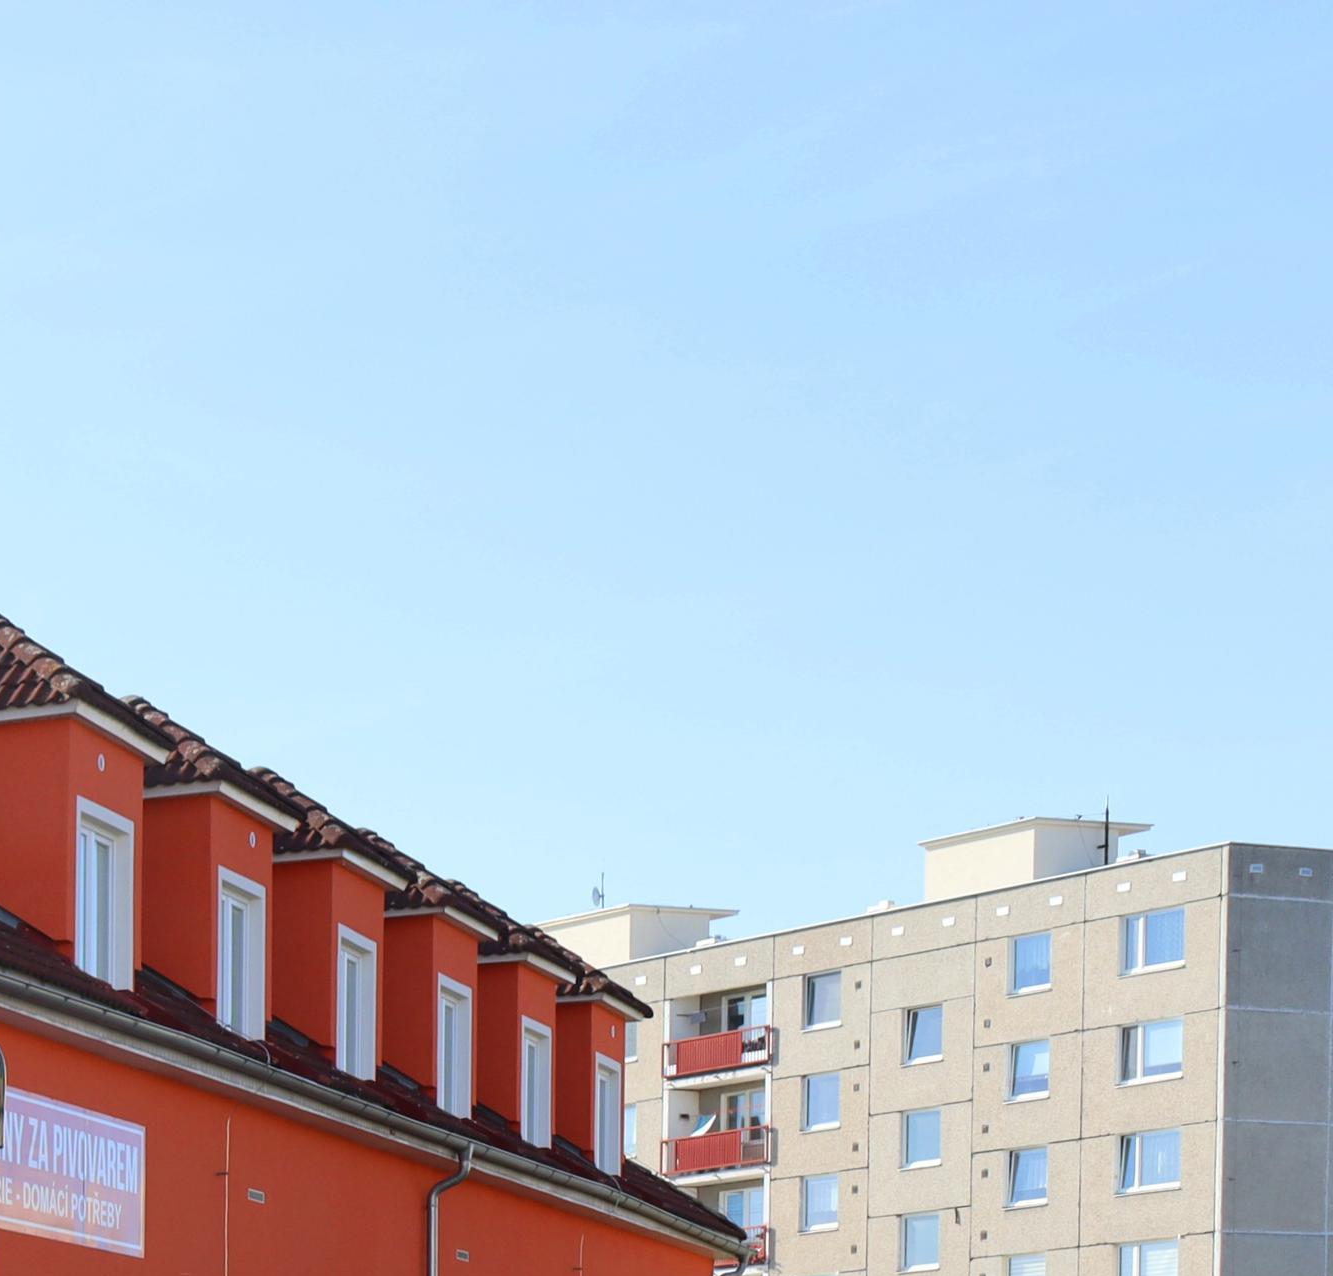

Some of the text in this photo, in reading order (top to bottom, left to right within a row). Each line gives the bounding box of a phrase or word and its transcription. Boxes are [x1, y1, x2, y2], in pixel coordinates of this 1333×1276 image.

[28, 1117, 49, 1172] ZA
[53, 1124, 139, 1195] PIVOVAREM
[23, 1182, 69, 1218] DOMÁCÍ
[71, 1192, 122, 1230] POTŘEBY
